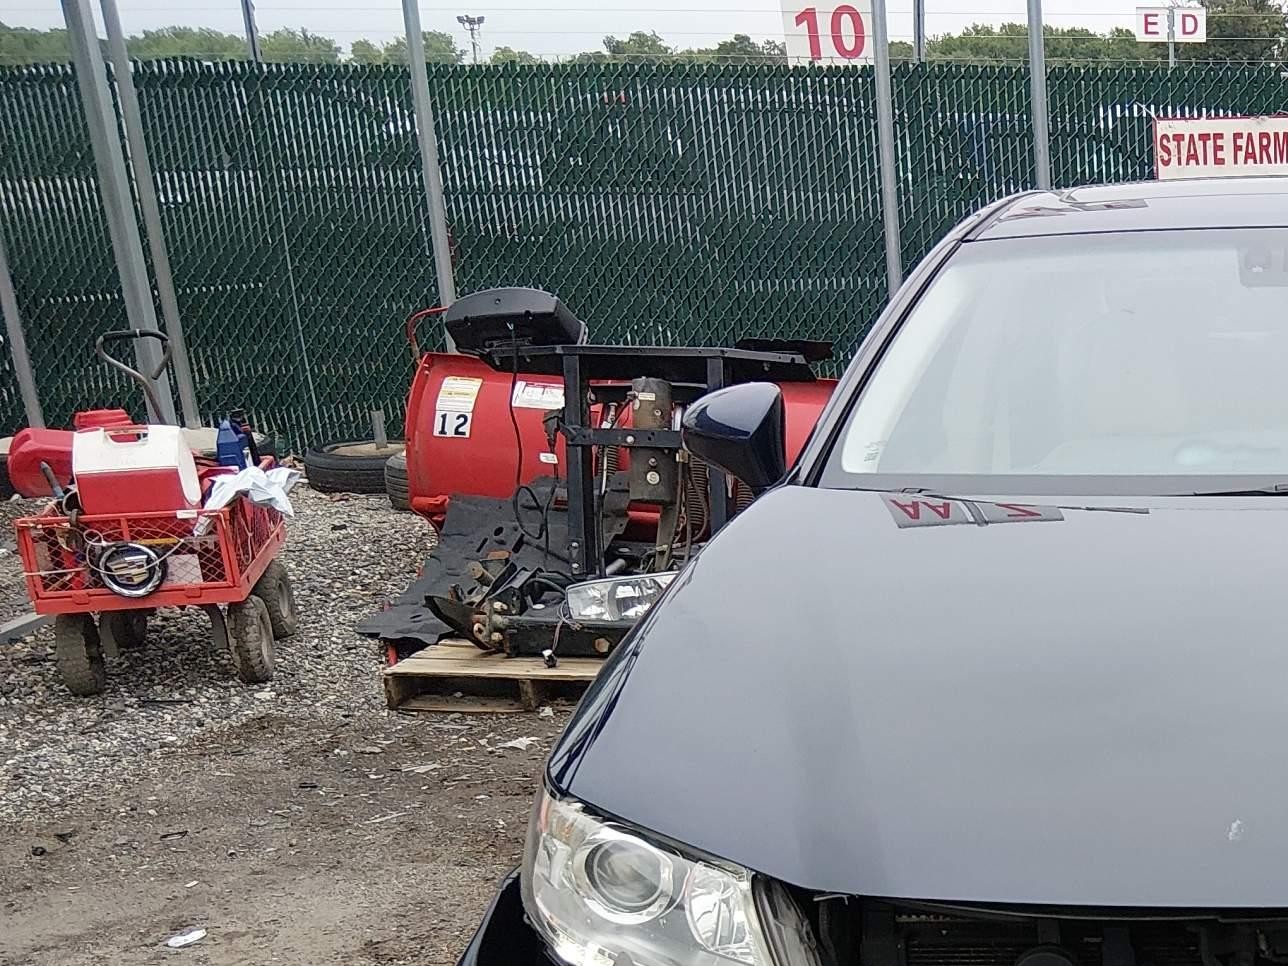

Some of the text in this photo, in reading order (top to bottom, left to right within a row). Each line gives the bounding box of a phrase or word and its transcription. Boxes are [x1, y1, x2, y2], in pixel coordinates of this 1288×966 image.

[795, 4, 866, 61] 10
[1144, 13, 1159, 36] E
[1180, 13, 1199, 36] D
[1158, 132, 1226, 167] STATE
[437, 413, 469, 436] 12
